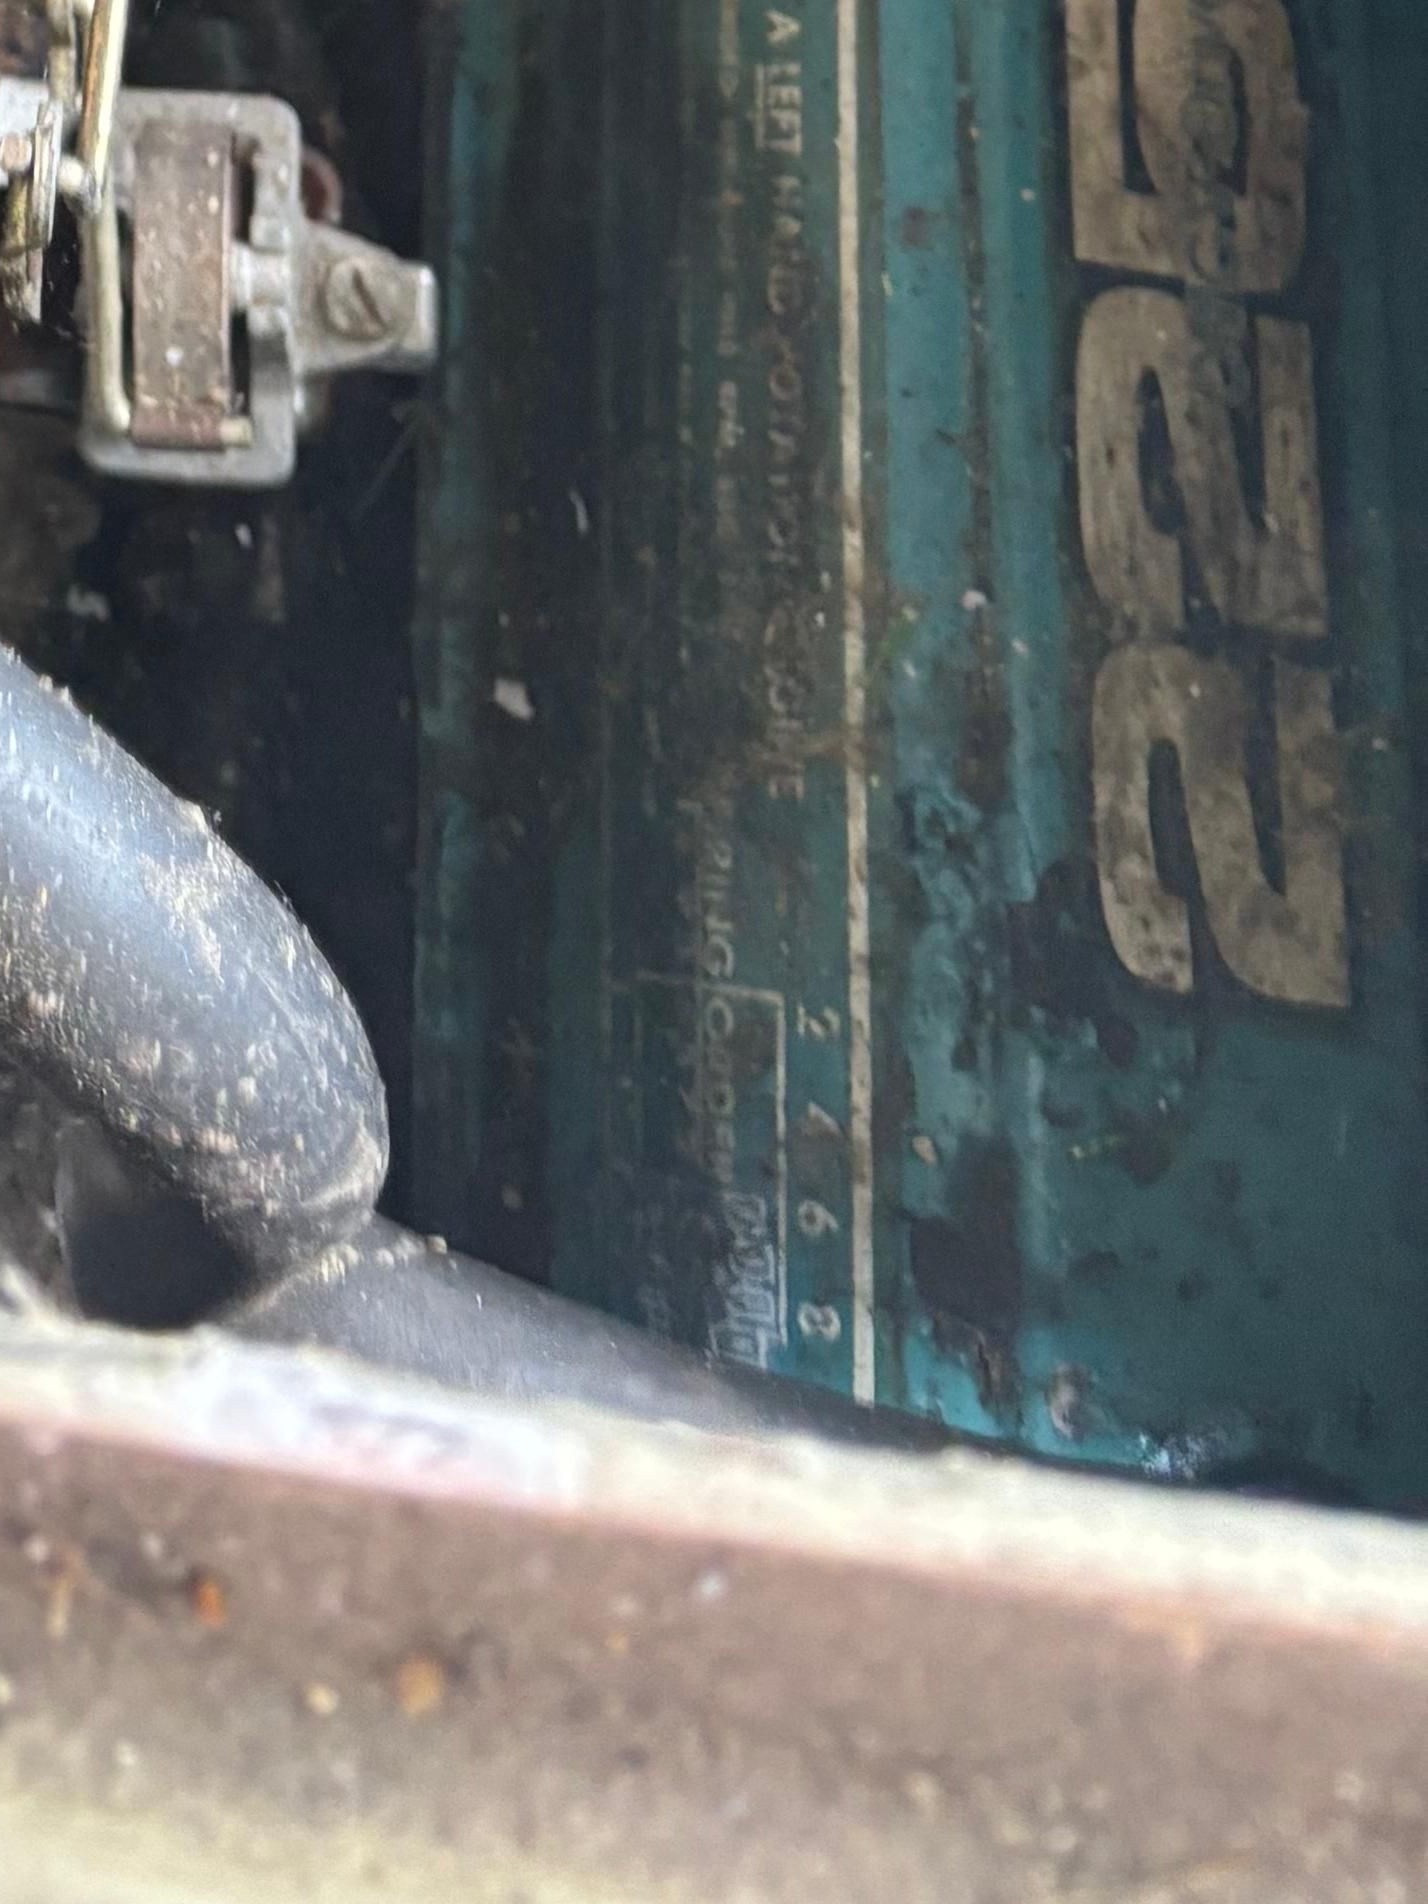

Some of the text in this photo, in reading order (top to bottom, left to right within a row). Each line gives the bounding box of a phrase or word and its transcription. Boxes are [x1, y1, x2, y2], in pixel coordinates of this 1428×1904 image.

[763, 9, 802, 47] A
[763, 60, 802, 157] LEFT
[795, 1004, 841, 1041] 2
[795, 1199, 839, 1238] 6
[795, 1301, 842, 1344] 8
